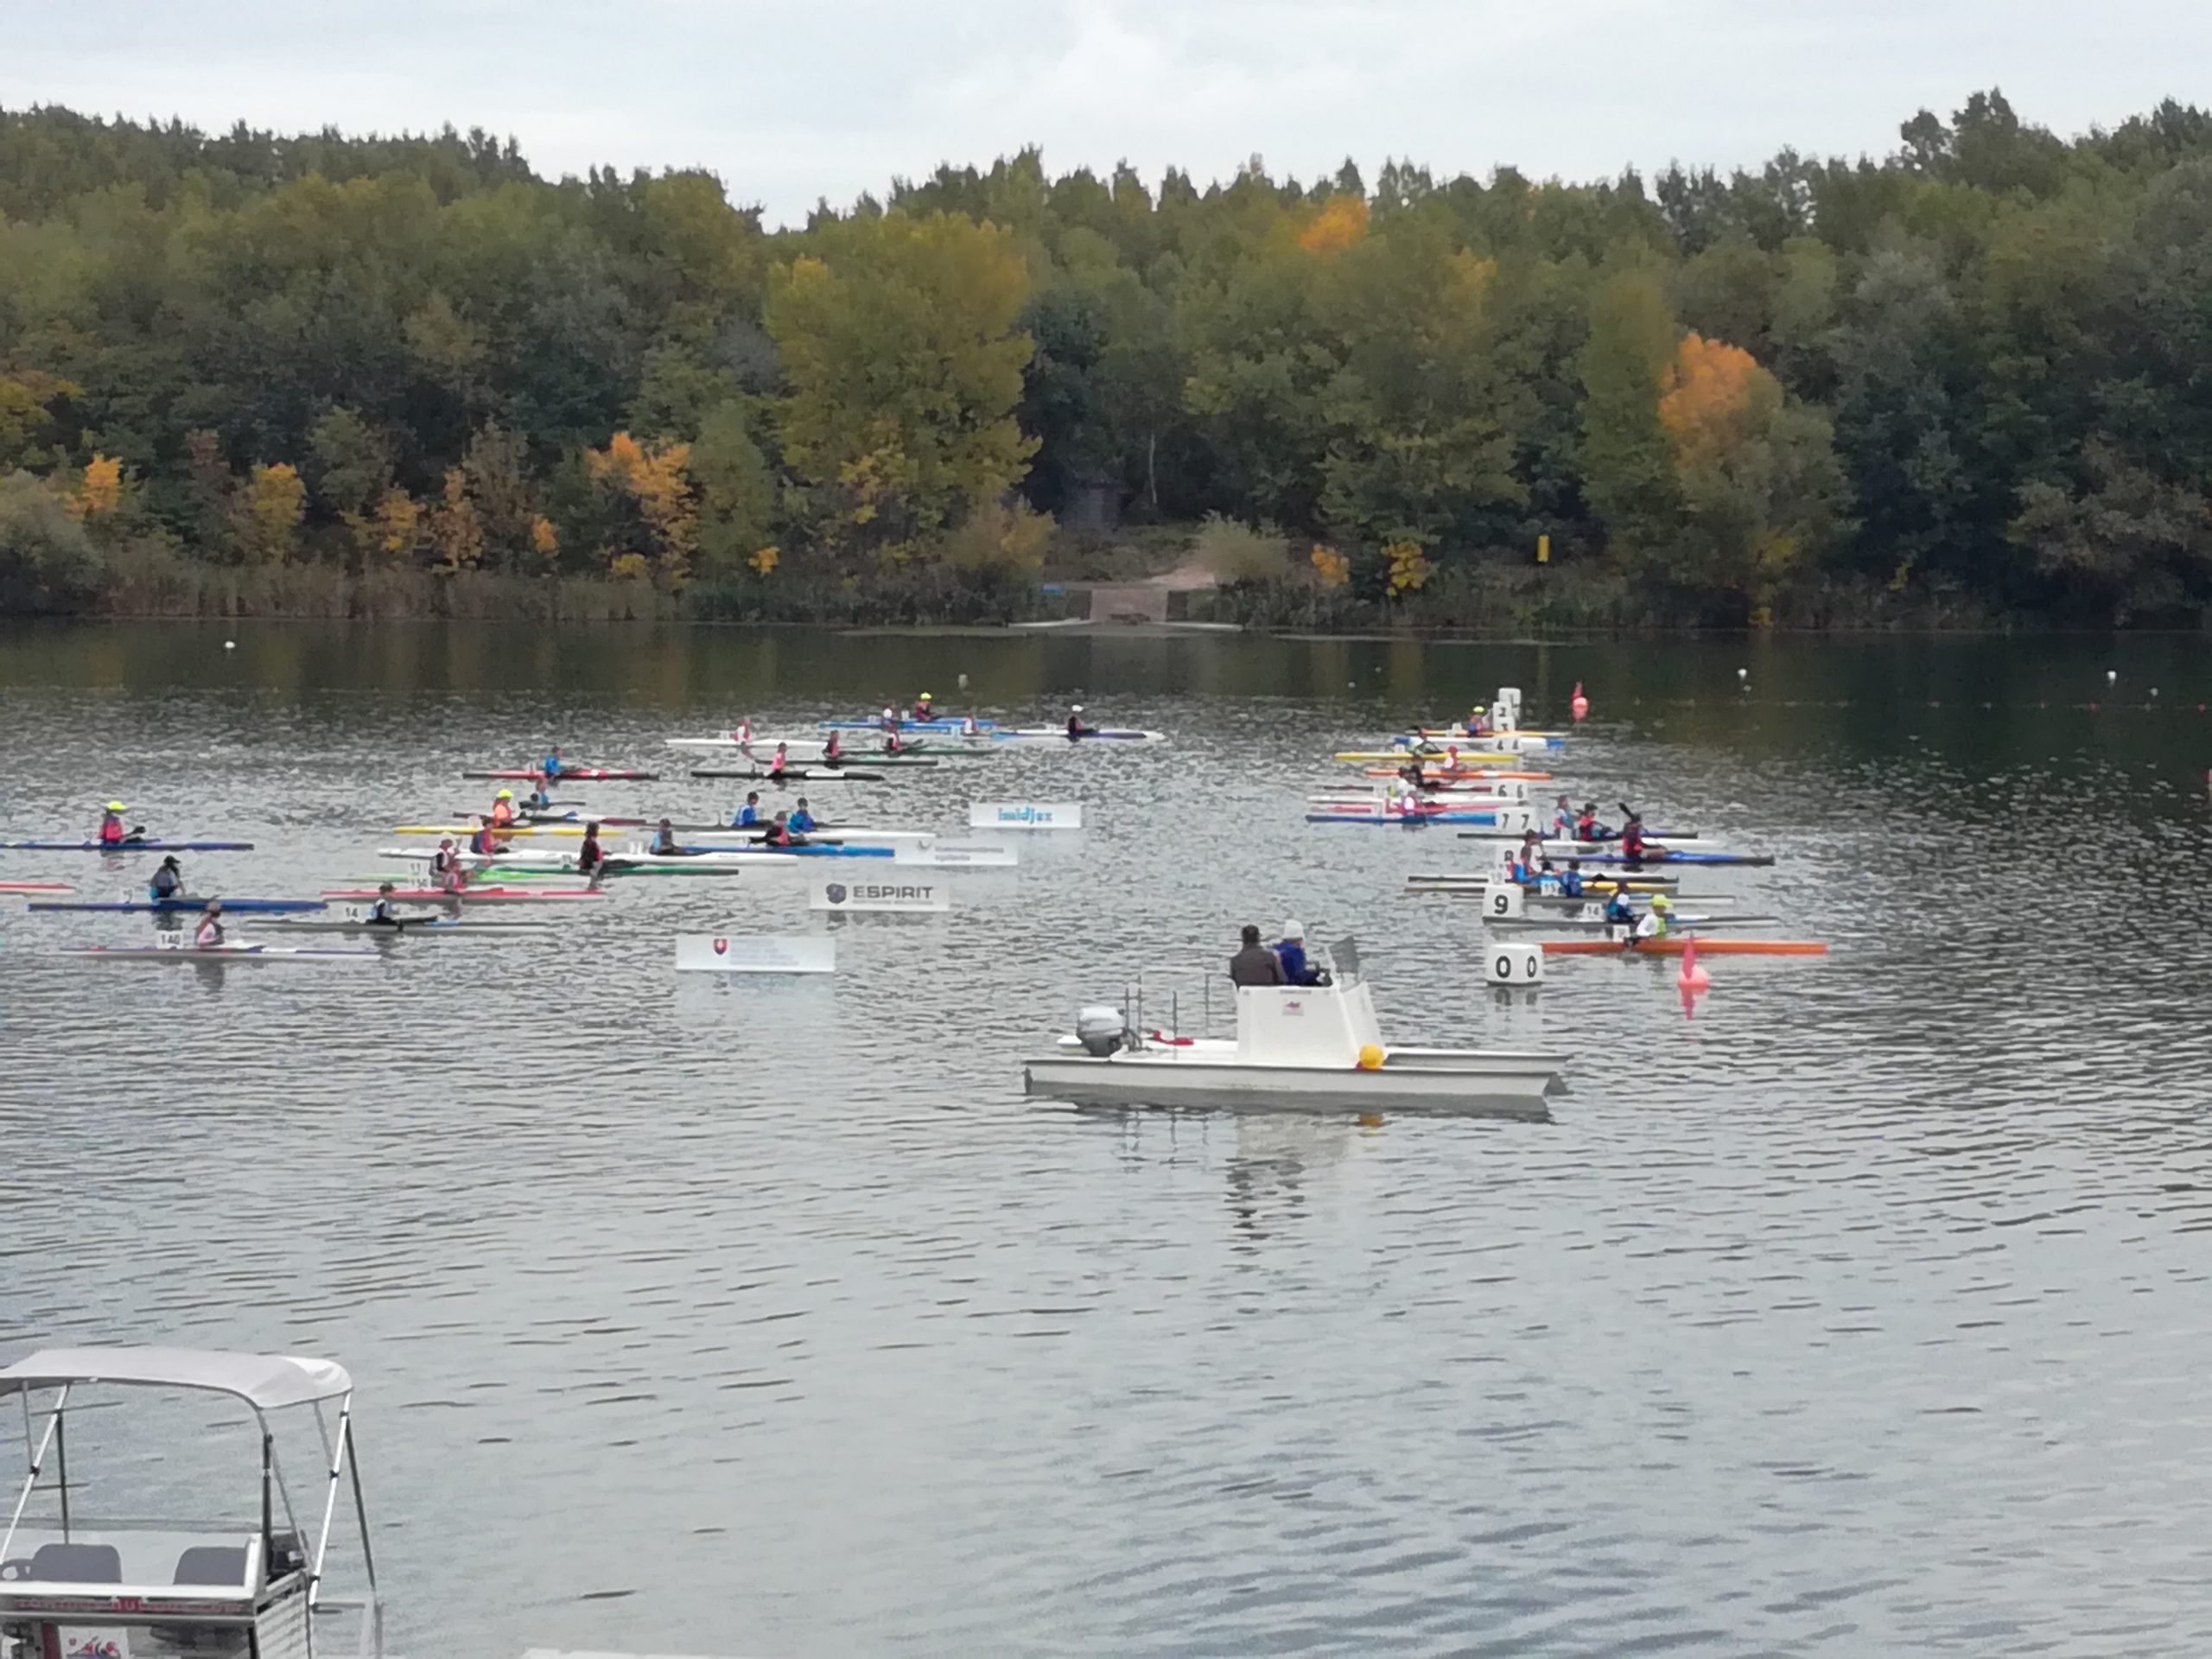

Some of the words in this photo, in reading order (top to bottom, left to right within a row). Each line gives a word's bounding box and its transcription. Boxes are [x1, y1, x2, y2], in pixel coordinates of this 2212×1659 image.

[1498, 707, 1507, 717] 2
[1497, 741, 1504, 750] 4
[1498, 785, 1507, 797] 6
[1517, 785, 1523, 798] 6
[1503, 813, 1510, 829] 7
[1521, 814, 1529, 830] 7
[853, 885, 933, 899] ESPIRIT
[1494, 894, 1509, 915] 9
[1496, 955, 1511, 978] 0
[1527, 955, 1537, 978] 0
